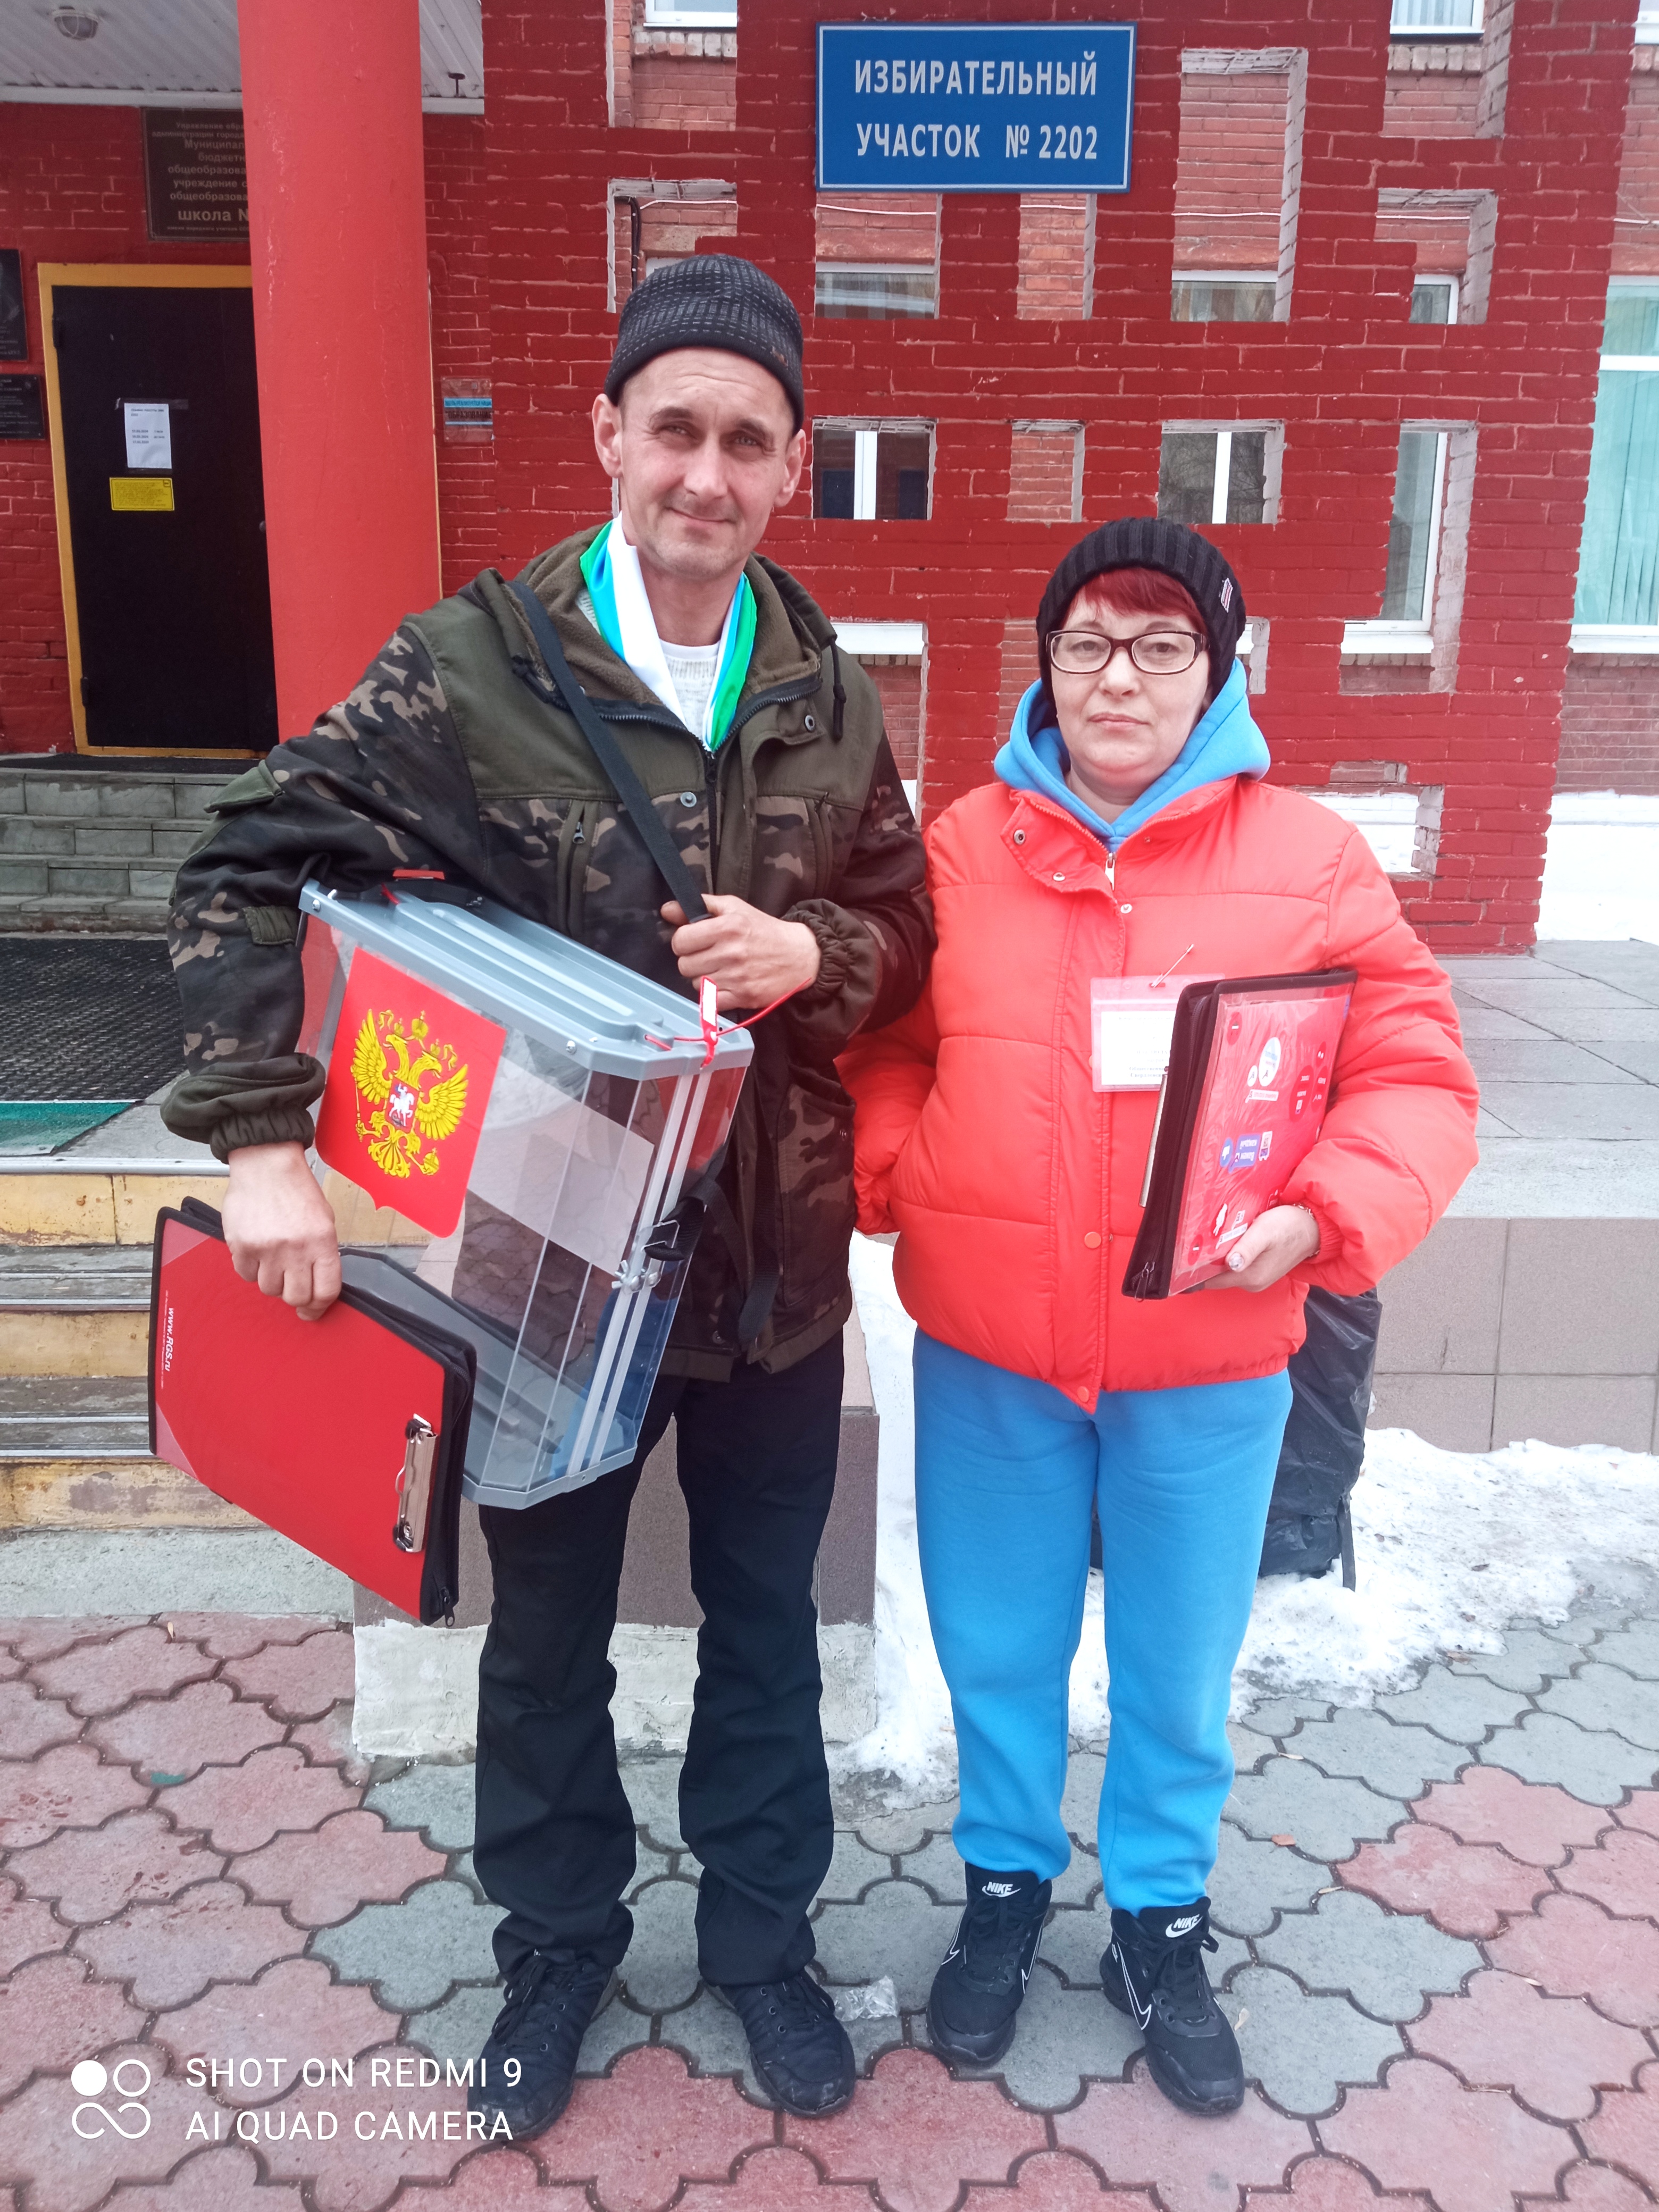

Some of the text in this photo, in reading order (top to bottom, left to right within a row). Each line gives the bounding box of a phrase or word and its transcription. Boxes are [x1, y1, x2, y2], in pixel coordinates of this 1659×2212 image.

[855, 51, 1096, 95] ИЗБИРАТЕЛЬНЫЙ
[857, 123, 1097, 159] УЧАСТОК № 2202
[173, 180, 238, 188] учреждение
[178, 210, 231, 221] школа
[165, 1308, 174, 1372] www.RGS.ru
[987, 1882, 1013, 1895] NIKE
[1174, 1914, 1201, 1930] NIKE
